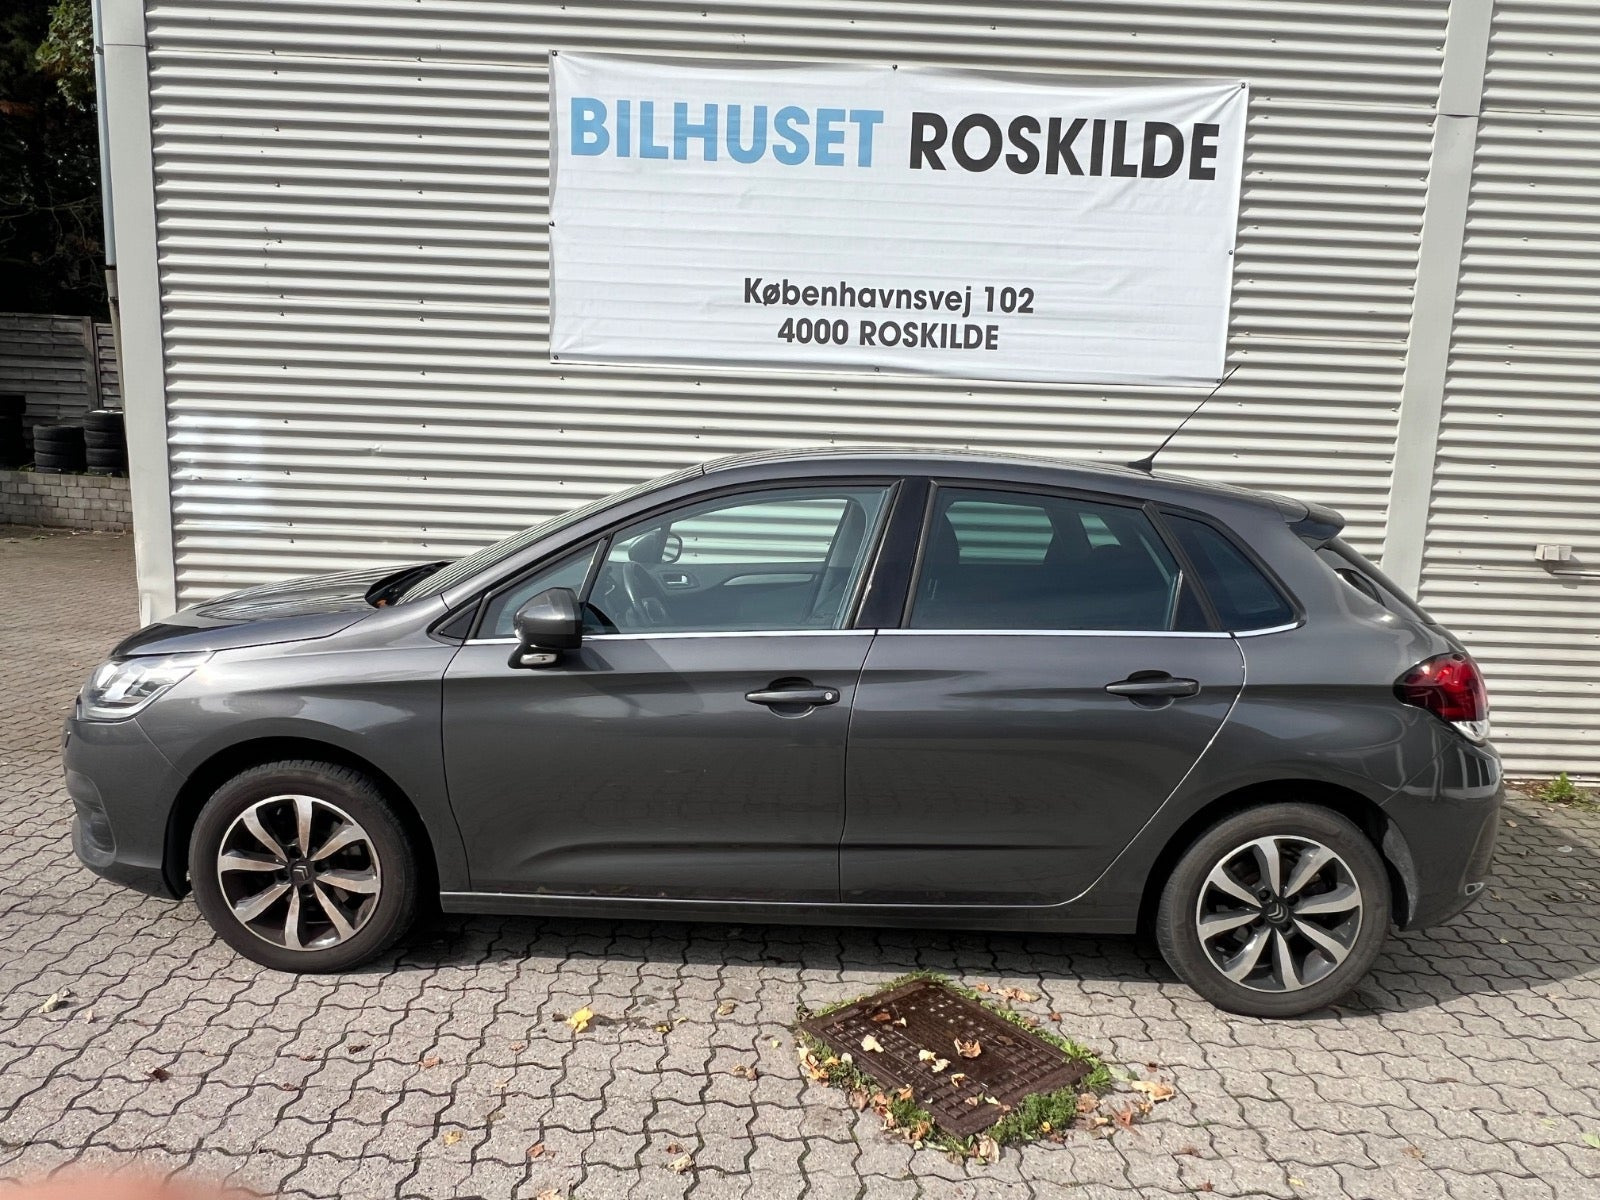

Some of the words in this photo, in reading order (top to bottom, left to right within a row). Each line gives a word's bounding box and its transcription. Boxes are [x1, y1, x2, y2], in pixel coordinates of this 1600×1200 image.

[570, 97, 884, 168] BILHUSET
[909, 111, 1220, 181] ROSKILDE
[744, 277, 972, 317] Københavnsvej
[984, 286, 1035, 314] 102
[777, 317, 849, 346] 4000
[859, 320, 999, 351] ROSKILDE
